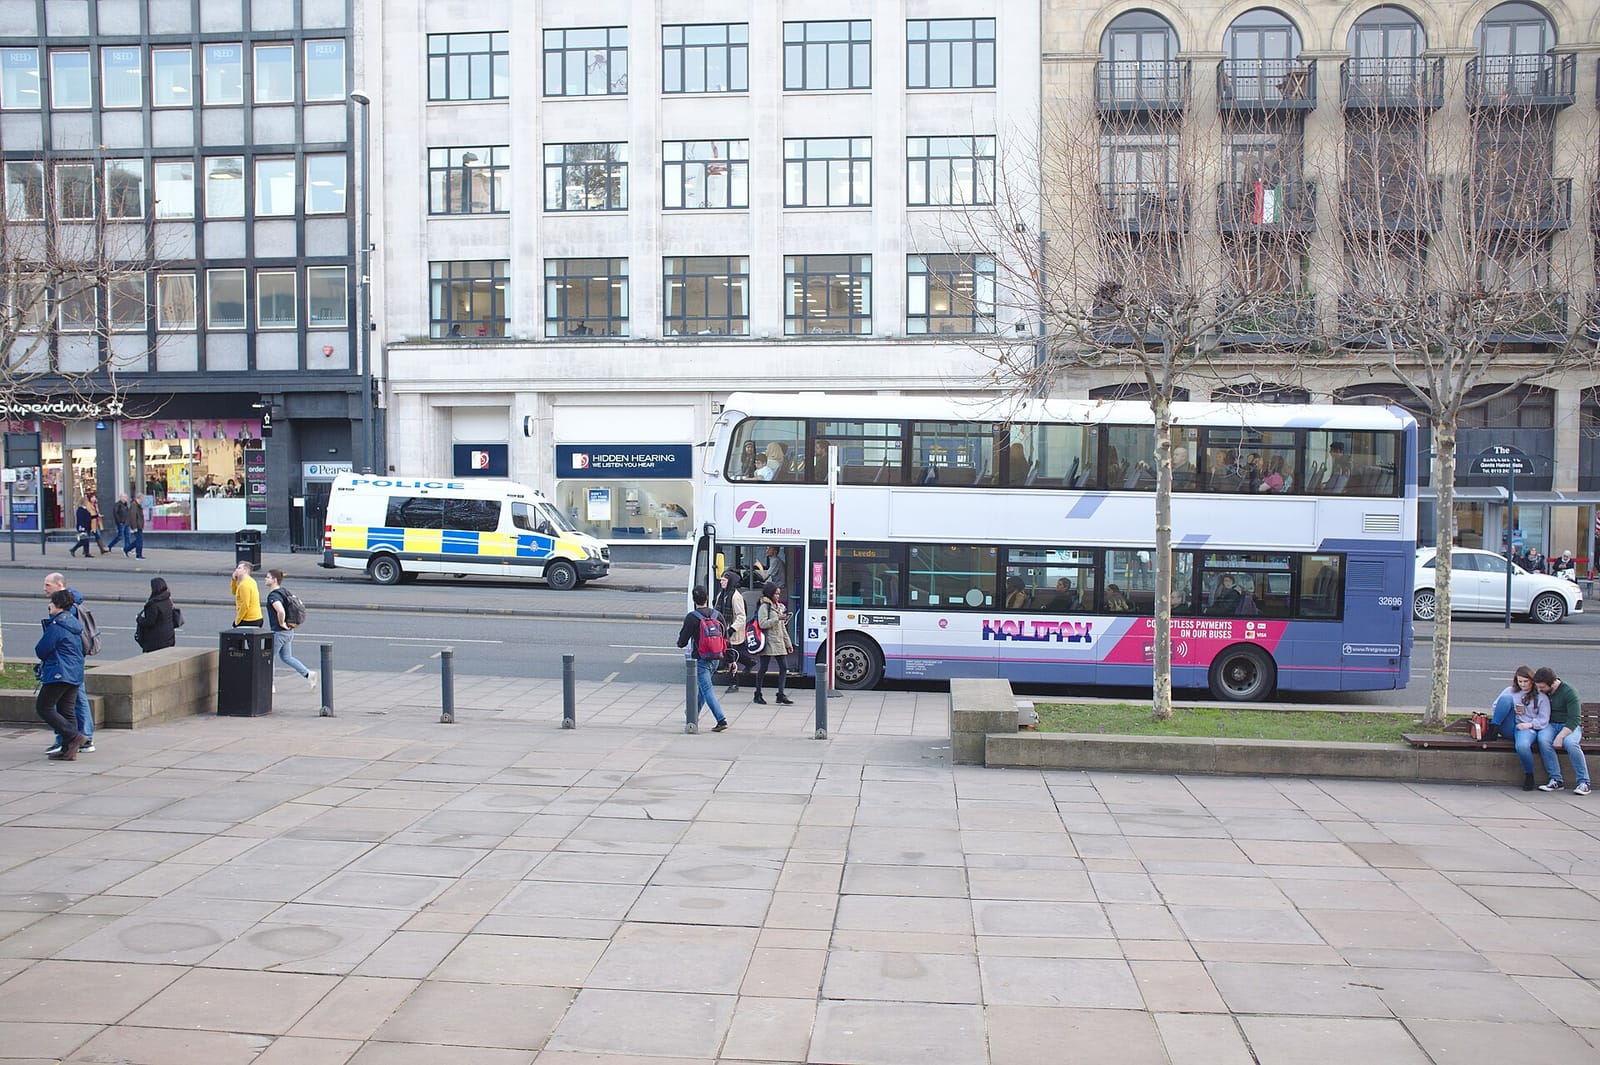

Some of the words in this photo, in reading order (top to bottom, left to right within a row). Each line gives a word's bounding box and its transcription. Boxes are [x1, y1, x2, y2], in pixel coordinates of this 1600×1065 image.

[0, 400, 101, 416] Superdrug
[1493, 446, 1510, 454] The
[592, 454, 629, 462] HIDDEN
[631, 454, 676, 462] HEARING
[319, 464, 353, 475] Pearso
[352, 479, 464, 489] POLICE
[853, 549, 876, 557] Leeds
[1378, 597, 1402, 606] 32696
[1146, 619, 1194, 630] COCTLESS
[1195, 620, 1232, 631] PAYMENTS
[982, 619, 1092, 643] HALIFAX
[1180, 629, 1191, 638] ON
[1192, 630, 1208, 639] OUR
[1209, 630, 1232, 640] BUSES
